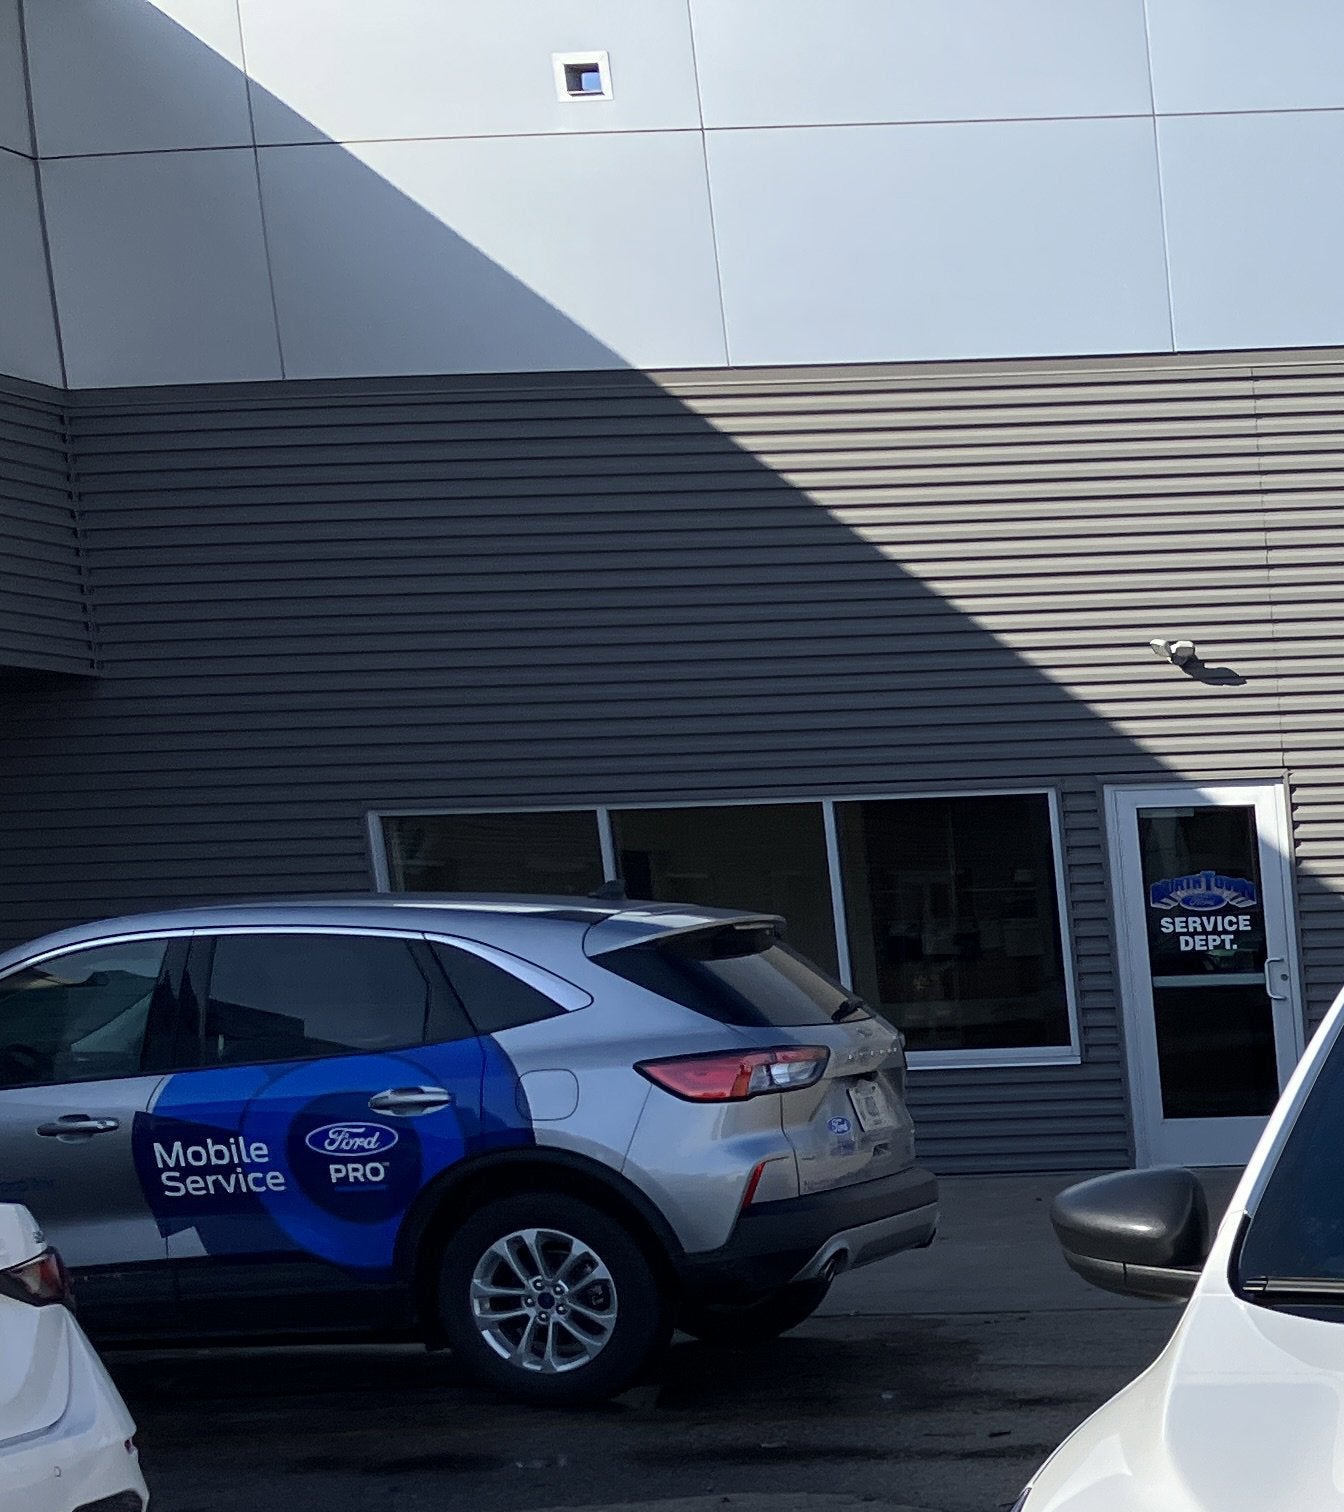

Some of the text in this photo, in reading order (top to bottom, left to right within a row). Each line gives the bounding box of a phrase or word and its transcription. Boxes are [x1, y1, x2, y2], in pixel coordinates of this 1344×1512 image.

[1160, 915, 1252, 933] SERVICE
[1180, 934, 1238, 951] DEPT.
[324, 1127, 381, 1151] Ford
[153, 1136, 269, 1168] Mobile
[161, 1167, 286, 1197] Service
